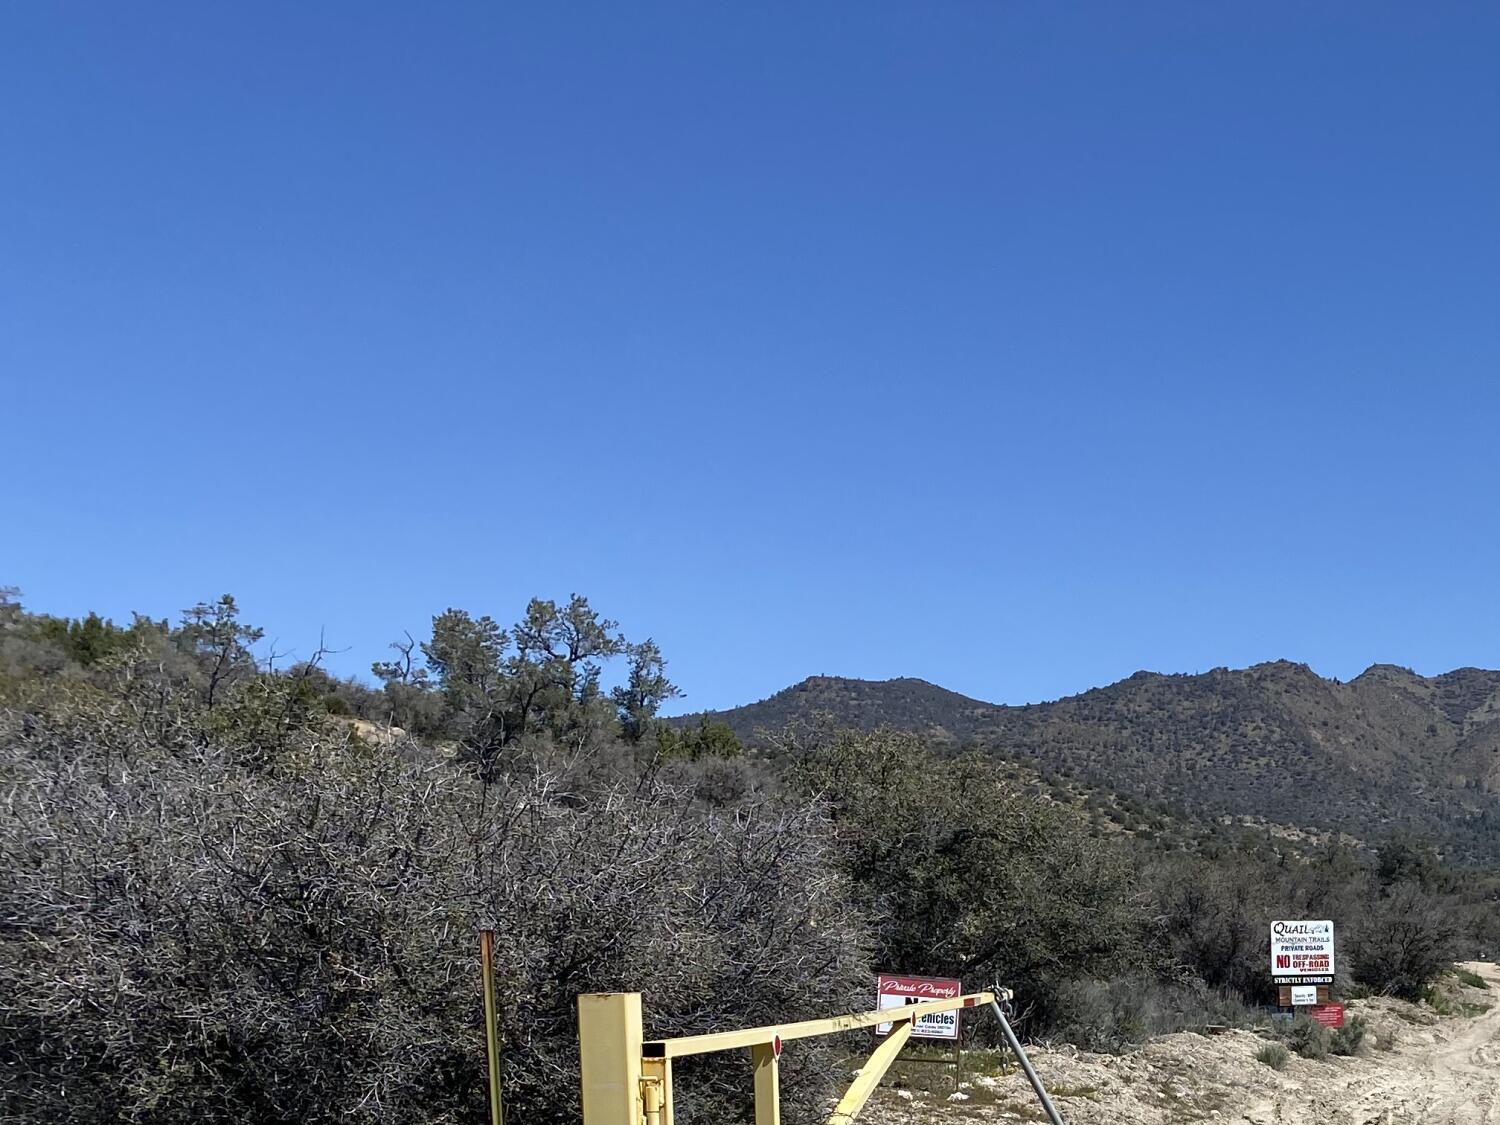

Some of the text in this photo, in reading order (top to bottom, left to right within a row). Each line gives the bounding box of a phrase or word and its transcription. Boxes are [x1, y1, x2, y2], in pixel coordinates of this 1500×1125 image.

[1273, 921, 1310, 936] QUAIL
[1276, 954, 1291, 968] NO
[882, 980, 956, 999] Private Property
[919, 1012, 955, 1025] ehicles
